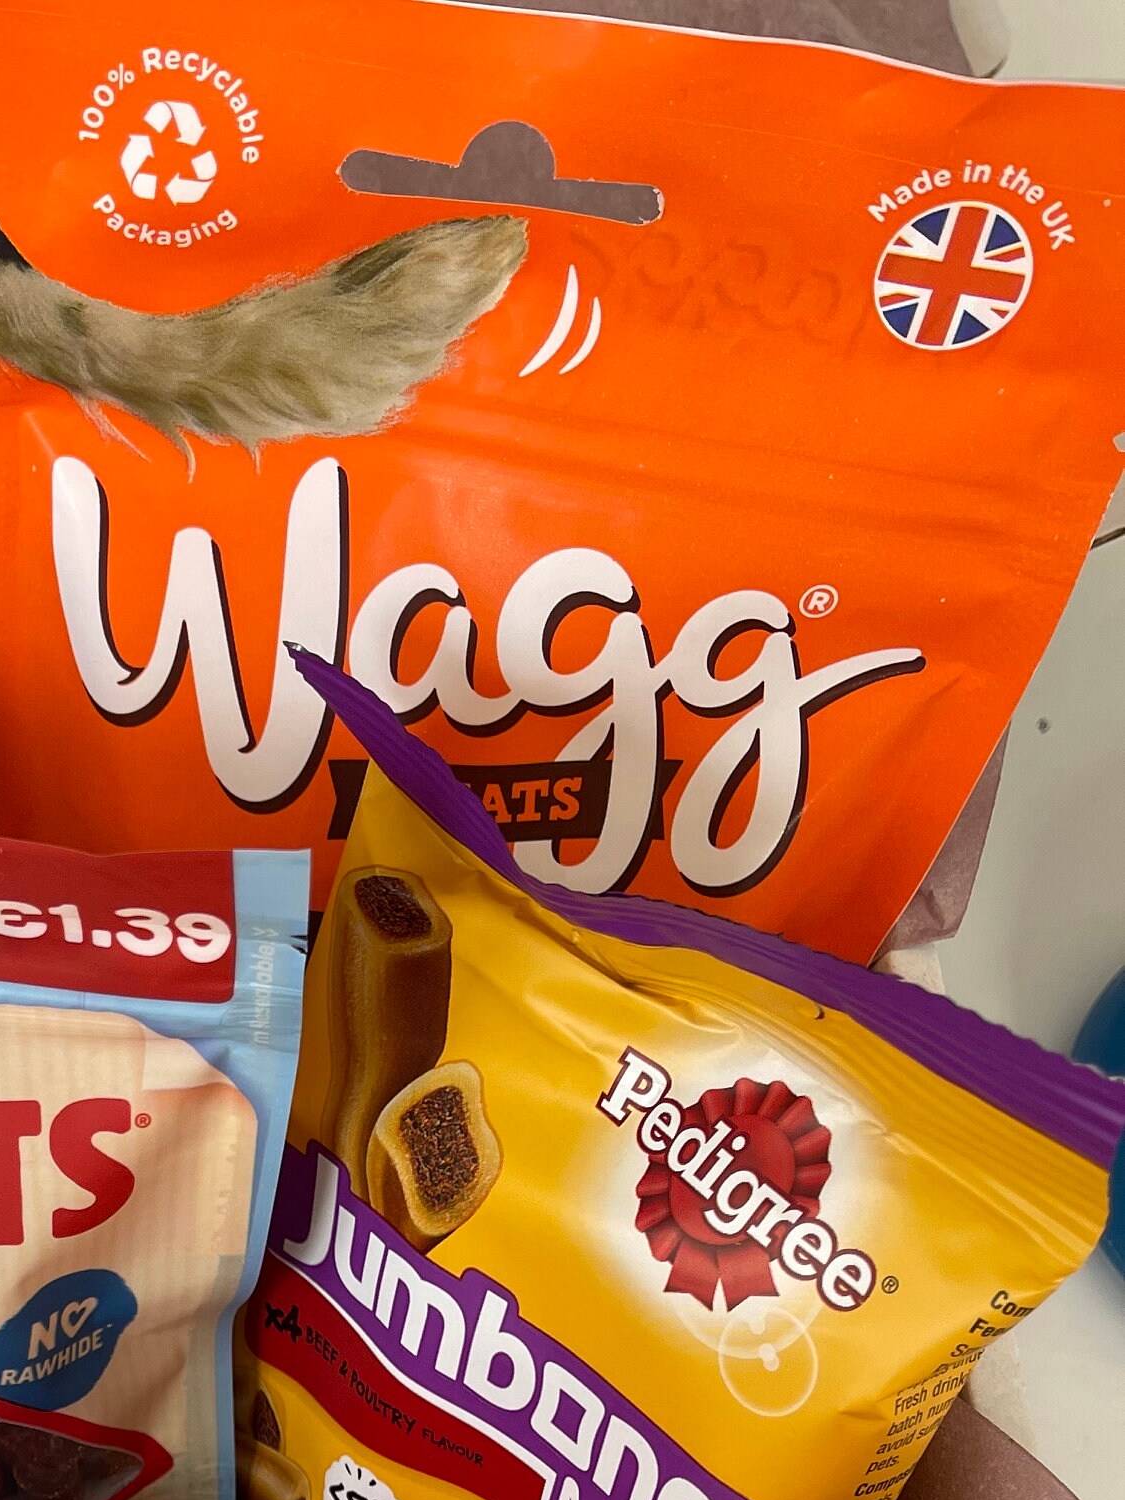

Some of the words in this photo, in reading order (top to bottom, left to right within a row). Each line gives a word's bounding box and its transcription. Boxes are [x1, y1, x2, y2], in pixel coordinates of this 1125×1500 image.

[78, 63, 135, 141] 100%
[142, 47, 264, 164] Recyclable
[93, 194, 238, 248] Packaging
[867, 169, 951, 222] Made
[963, 159, 991, 183] in
[999, 164, 1045, 204] the
[1042, 201, 1075, 251] UK
[51, 456, 927, 895] Wagg
[597, 1047, 876, 1311] Pedigree
[0, 1327, 104, 1386] RAWHIDE
[27, 1297, 98, 1360] NO
[306, 1326, 339, 1365] BEEF
[349, 1370, 417, 1434] POULTRY
[422, 1428, 483, 1467] FLAVOUR
[887, 1409, 923, 1436] batch
[895, 1387, 928, 1416] Fresh
[876, 1429, 916, 1454] avoid
